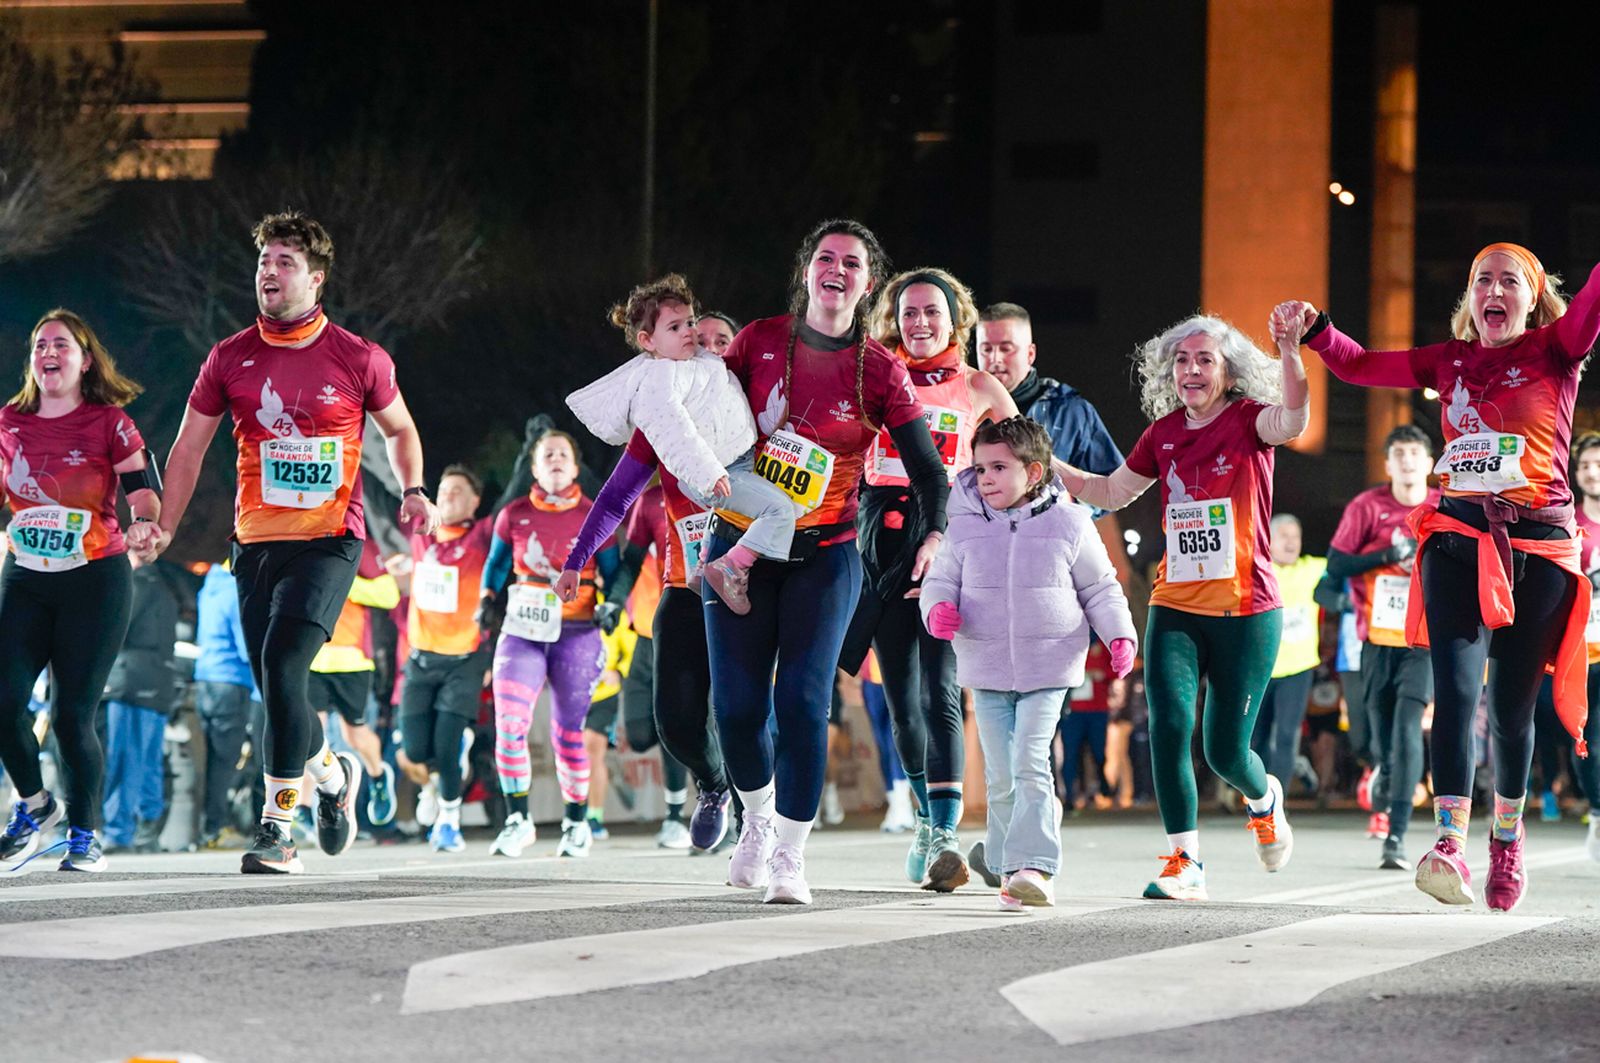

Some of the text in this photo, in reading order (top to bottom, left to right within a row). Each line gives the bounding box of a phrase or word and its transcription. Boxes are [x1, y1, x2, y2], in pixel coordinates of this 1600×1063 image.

[272, 417, 294, 438] 43
[1458, 413, 1480, 434] 43
[278, 444, 302, 452] NOCHE
[791, 444, 803, 454] DE
[1481, 442, 1491, 450] DE
[270, 452, 285, 460] SAN
[770, 449, 800, 465] ANTÓN
[272, 461, 332, 484] 12532
[755, 454, 812, 496] 4049
[19, 482, 40, 500] 43
[1178, 510, 1203, 519] NOCHE DE
[1173, 521, 1185, 530] SAN
[17, 527, 75, 552] 13754
[1179, 528, 1221, 555] 6353
[516, 605, 550, 623] 4460
